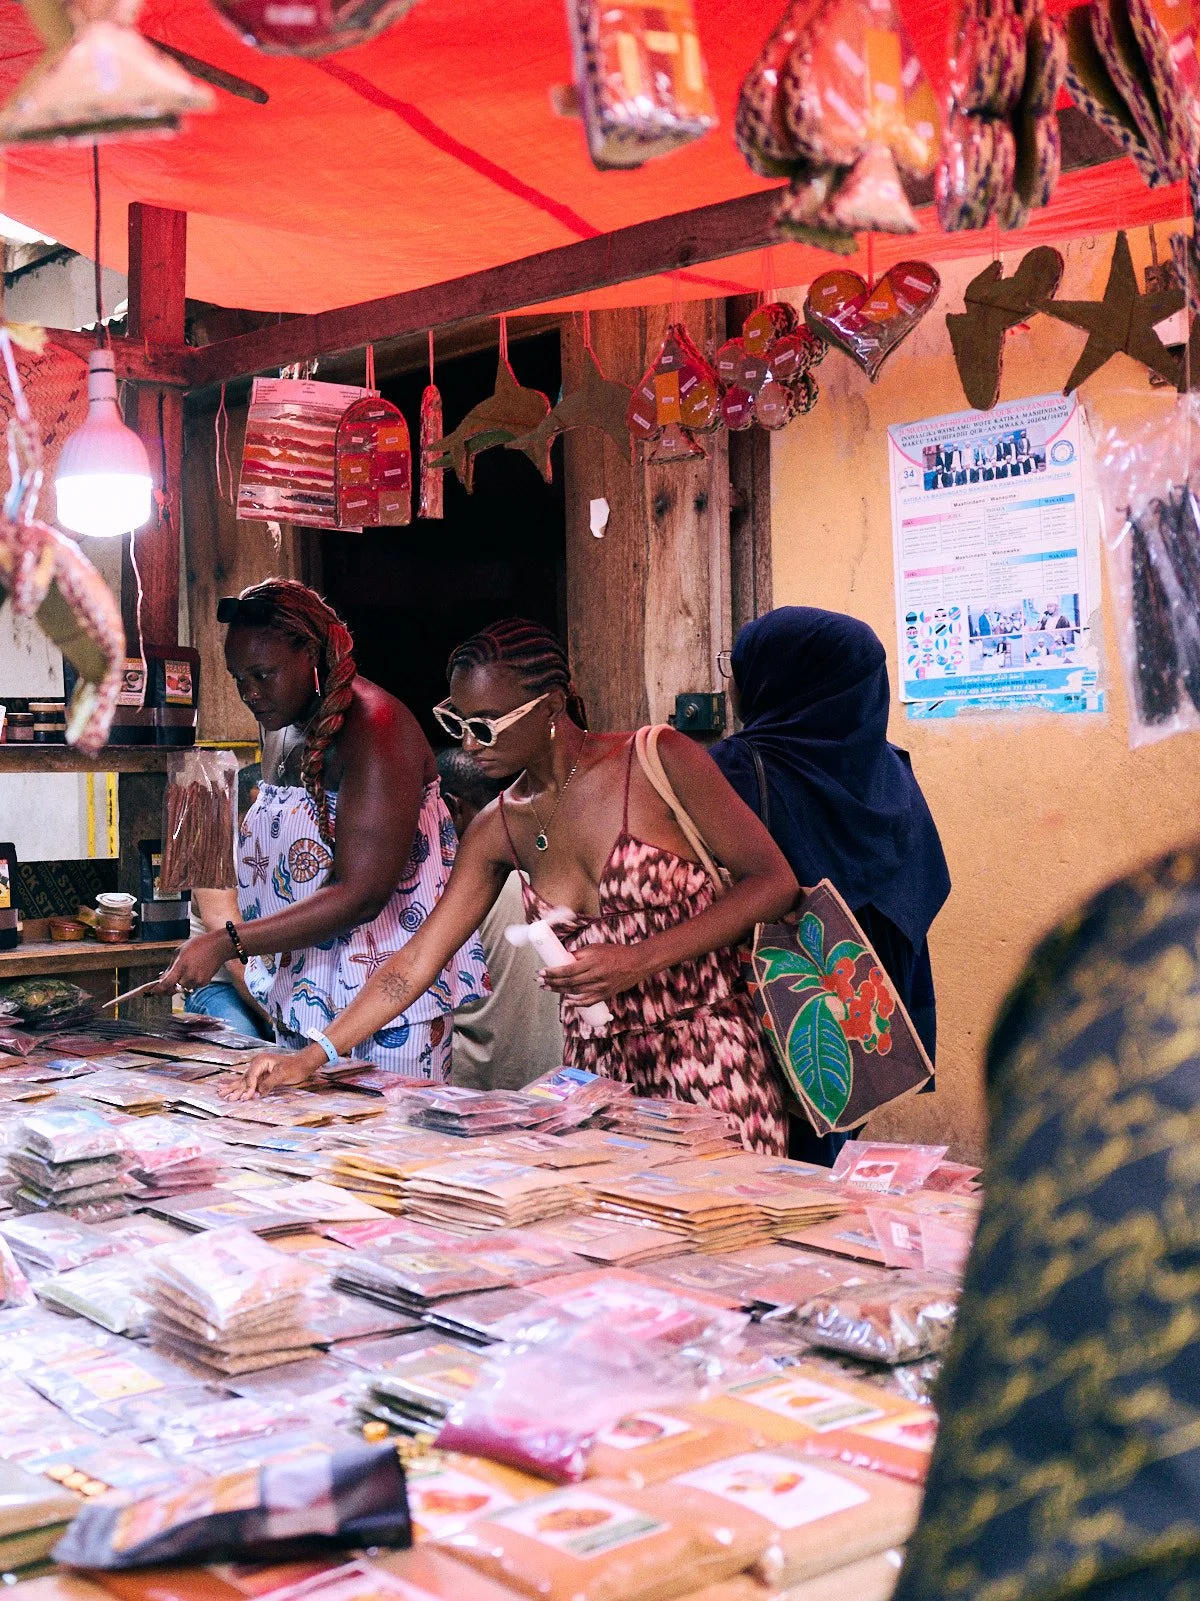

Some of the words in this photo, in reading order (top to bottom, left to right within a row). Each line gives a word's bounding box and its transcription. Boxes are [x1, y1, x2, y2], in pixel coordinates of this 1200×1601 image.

[973, 419, 991, 428] WOTE
[994, 414, 1020, 424] KATIKA
[1022, 404, 1067, 418] MASHINDANO
[998, 420, 1024, 430] MWAKA
[903, 470, 914, 479] 34
[165, 664, 190, 674] ORANGE
